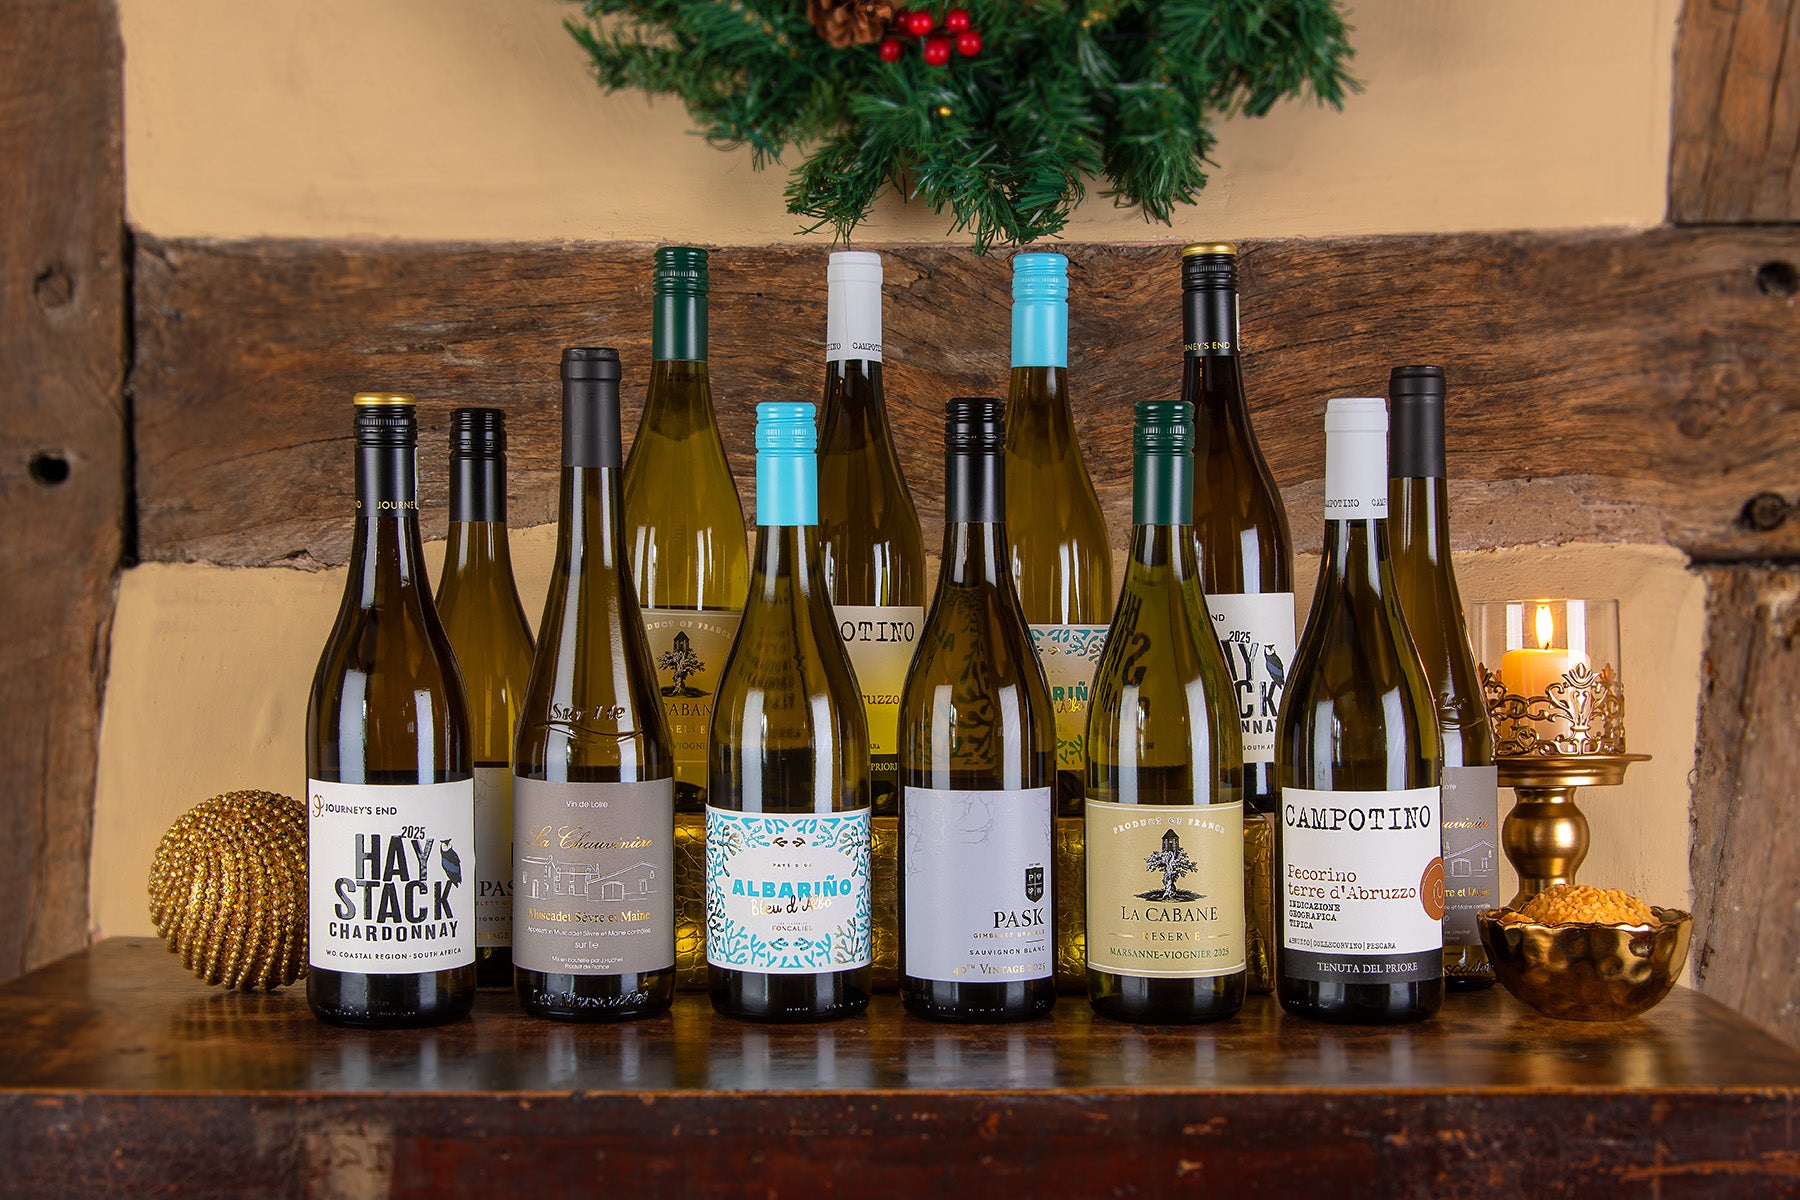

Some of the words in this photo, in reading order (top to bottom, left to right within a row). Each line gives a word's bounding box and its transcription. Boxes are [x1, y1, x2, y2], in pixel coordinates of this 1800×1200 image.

[1212, 341, 1230, 350] END
[679, 620, 693, 628] OF
[697, 622, 731, 639] FRANCE
[840, 620, 915, 643] OTINO
[1229, 630, 1251, 643] 2025
[1052, 681, 1089, 701] RIÑ
[1241, 719, 1277, 734] NNA
[325, 803, 372, 815] JOURNEY'S
[376, 806, 397, 815] END
[566, 800, 578, 808] Vin
[579, 800, 590, 808] de
[1285, 804, 1431, 831] CAMPOTINO
[401, 825, 426, 840] 2025
[1112, 817, 1162, 835] PRODUCT
[1168, 817, 1182, 825] OF
[1187, 817, 1226, 835] FRANCE
[527, 823, 552, 848] La
[355, 833, 434, 881] HAY
[1287, 864, 1357, 882] Pecorino
[732, 874, 851, 898] ALBARIÑO
[1288, 881, 1325, 898] terre
[1330, 885, 1417, 900] d'Abruzzo
[334, 877, 454, 923] STACK
[751, 898, 782, 917] Bleu
[786, 893, 833, 914] d'Albo
[1288, 900, 1341, 912] INDICAZIONE
[527, 907, 572, 923] Muscadet
[574, 912, 605, 923] Sèvre
[608, 912, 617, 922] et
[621, 909, 651, 922] Maine
[993, 907, 1045, 929] PASK
[1145, 906, 1219, 922] CABANE
[1288, 909, 1337, 922] GEOGRAFICA
[329, 920, 459, 942] CHARDONNAY
[1289, 919, 1314, 930] TIPICA
[1142, 932, 1201, 941] RESERVE
[574, 941, 587, 949] sur
[1023, 946, 1045, 954] BLANC
[1366, 942, 1396, 950] PESCARA
[339, 951, 372, 959] COASTAL
[413, 951, 438, 959] SOUTH
[439, 947, 461, 957] AFRICA
[1109, 947, 1211, 960] MARSANNE-VIOGNIER
[1213, 947, 1230, 958] 2025
[1317, 962, 1360, 973] TENUTA
[1363, 964, 1384, 974] DEL
[1385, 962, 1418, 973] PRIORE
